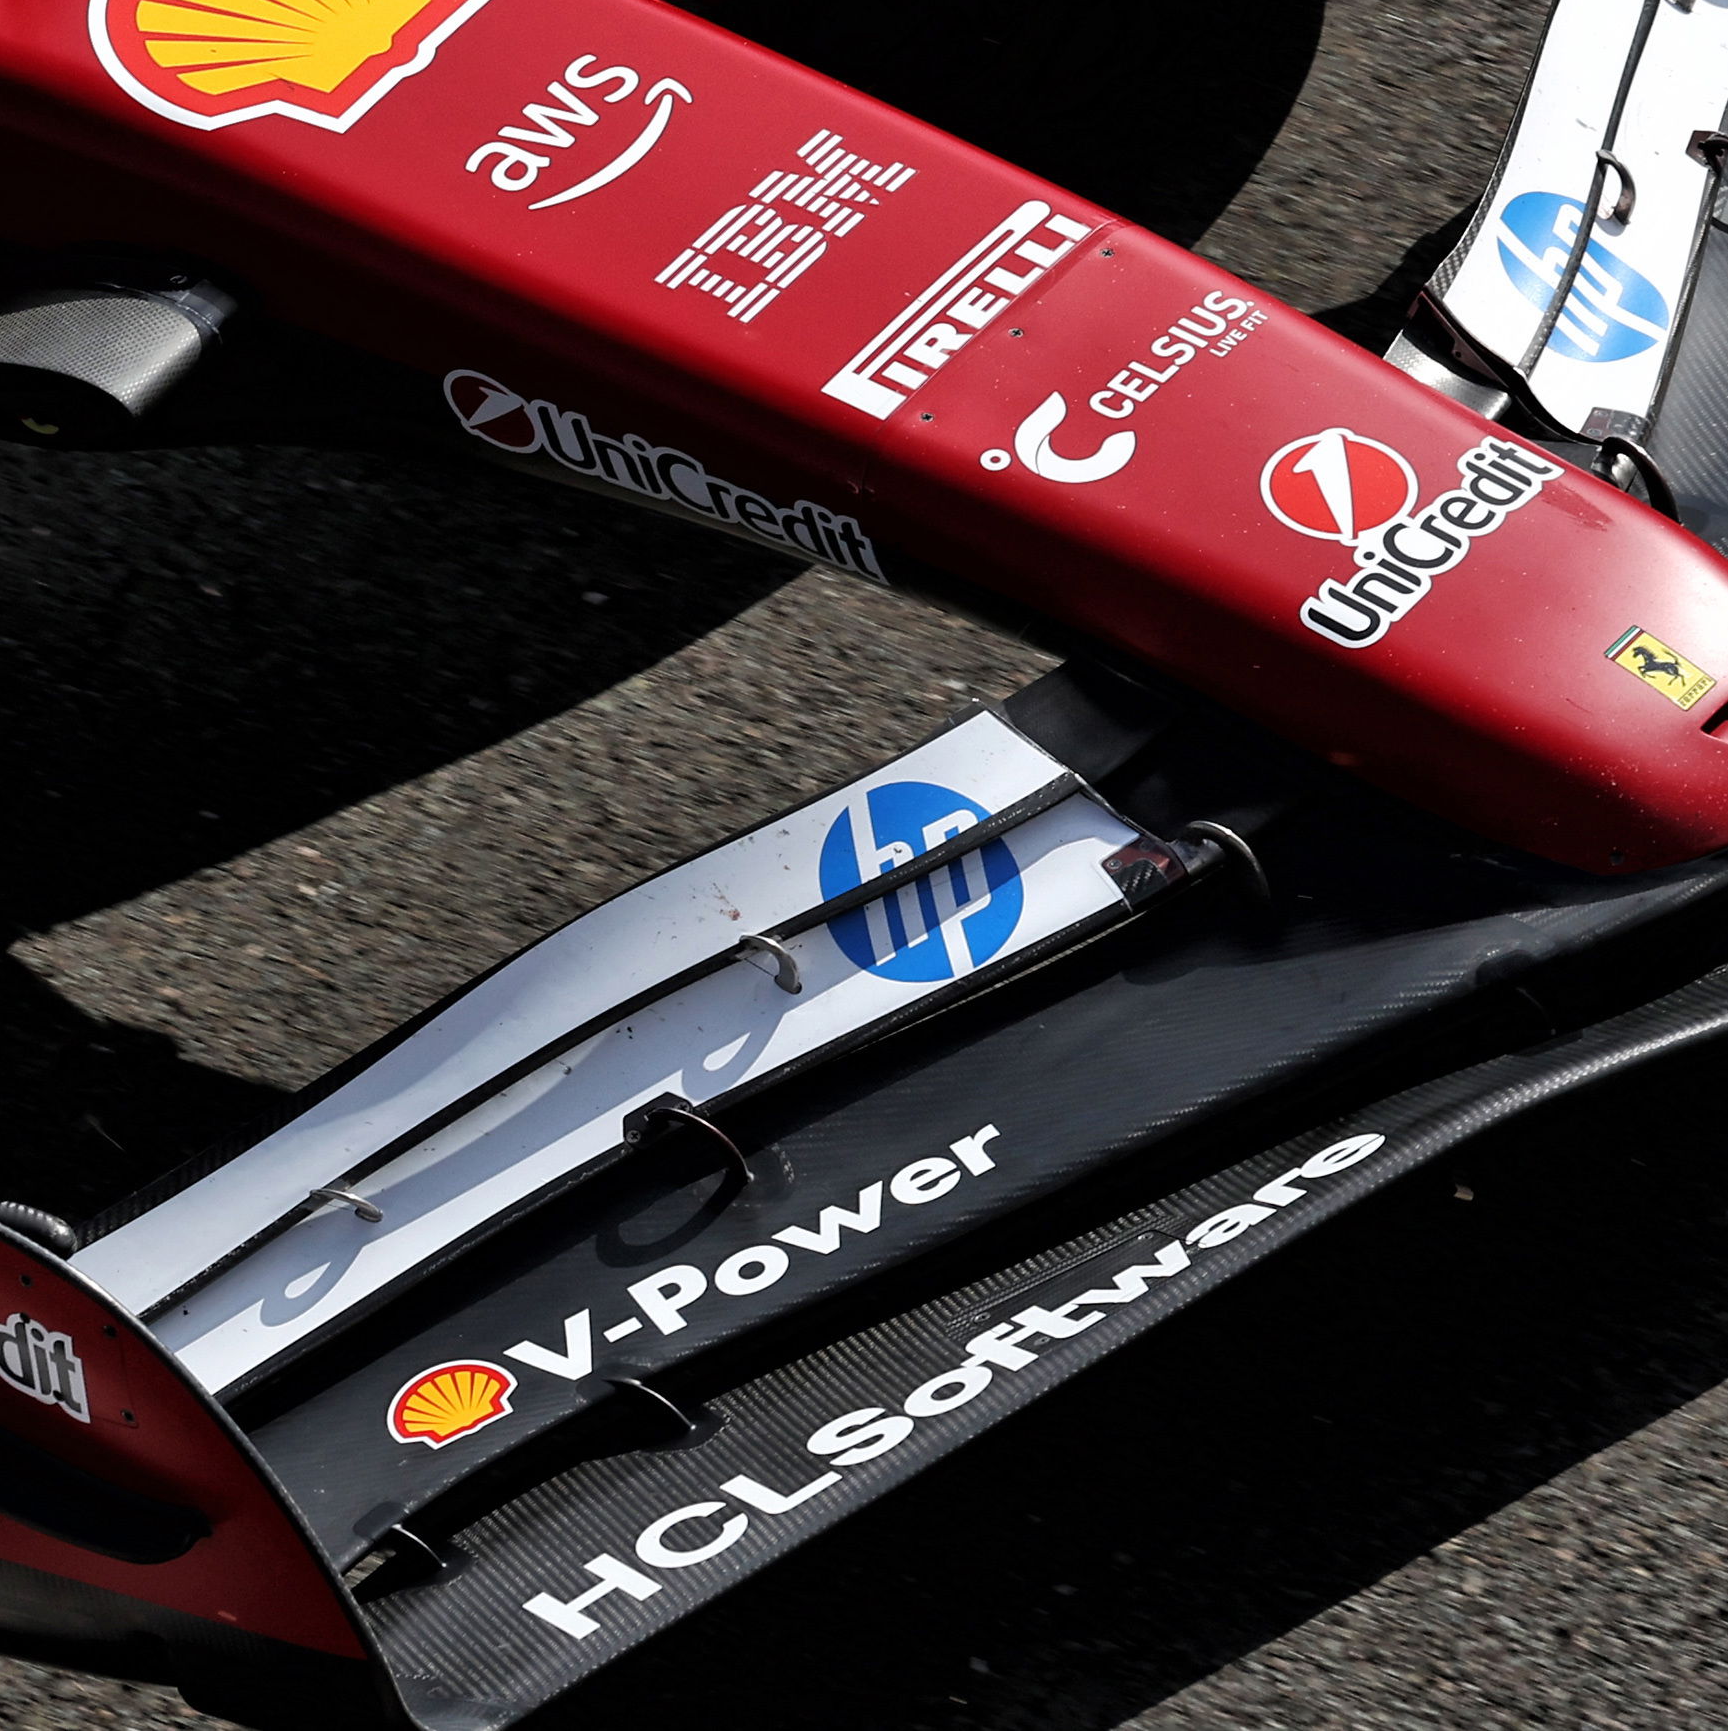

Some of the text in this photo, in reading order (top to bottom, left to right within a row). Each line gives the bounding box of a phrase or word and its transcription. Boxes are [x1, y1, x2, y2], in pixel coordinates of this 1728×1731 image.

[464, 53, 640, 192] aws
[653, 128, 917, 324] IBM
[819, 199, 1092, 421] PIRELLI
[1208, 309, 1269, 358] LIVE FIT
[536, 402, 883, 582] UniCredit
[1306, 439, 1558, 641] UniCredit
[849, 790, 995, 977] hp
[503, 1122, 1001, 1382] V-Power
[522, 1132, 1387, 1641] HCLSoftware
